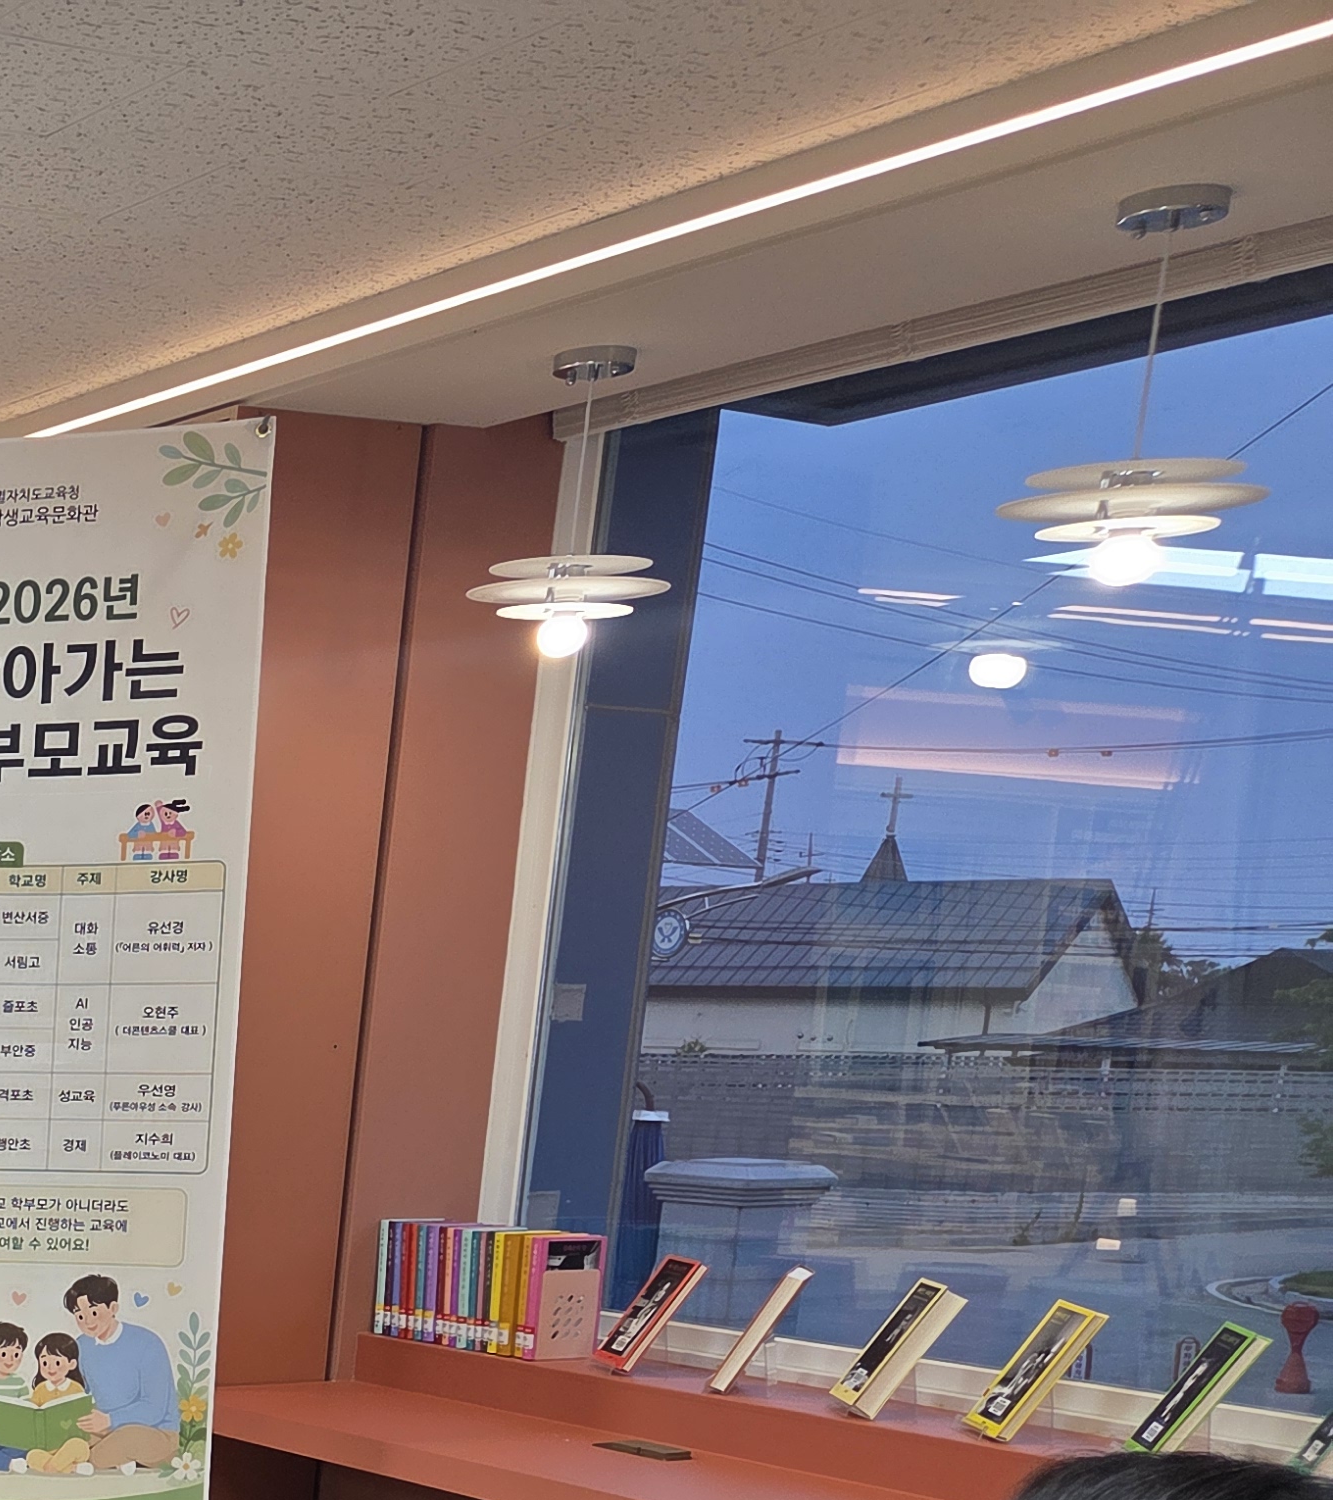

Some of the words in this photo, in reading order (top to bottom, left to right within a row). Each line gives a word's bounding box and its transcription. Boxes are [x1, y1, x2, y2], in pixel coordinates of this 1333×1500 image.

[9, 874, 47, 887] 학교명
[77, 872, 102, 885] 주제
[150, 869, 188, 883] 강사명
[2, 911, 49, 925] 변산서중
[74, 922, 98, 935] 대화
[147, 921, 184, 935] 유선경
[75, 998, 88, 1009] AI
[142, 1006, 179, 1019] 오현주
[69, 1018, 93, 1031] 인공
[0, 1044, 36, 1057] 부안중
[68, 1038, 92, 1051] 지능
[58, 1090, 95, 1103] 성교육
[137, 1084, 176, 1097] 우선영
[62, 1139, 87, 1152] 경제
[135, 1133, 173, 1146] 지수희
[11, 1197, 61, 1211] 학부모가
[66, 1198, 129, 1212] 아니더라도
[35, 1217, 85, 1232] 진행하는
[90, 1218, 128, 1232] 교육에
[28, 1237, 41, 1251] 수
[47, 1237, 89, 1251] 있어요!
